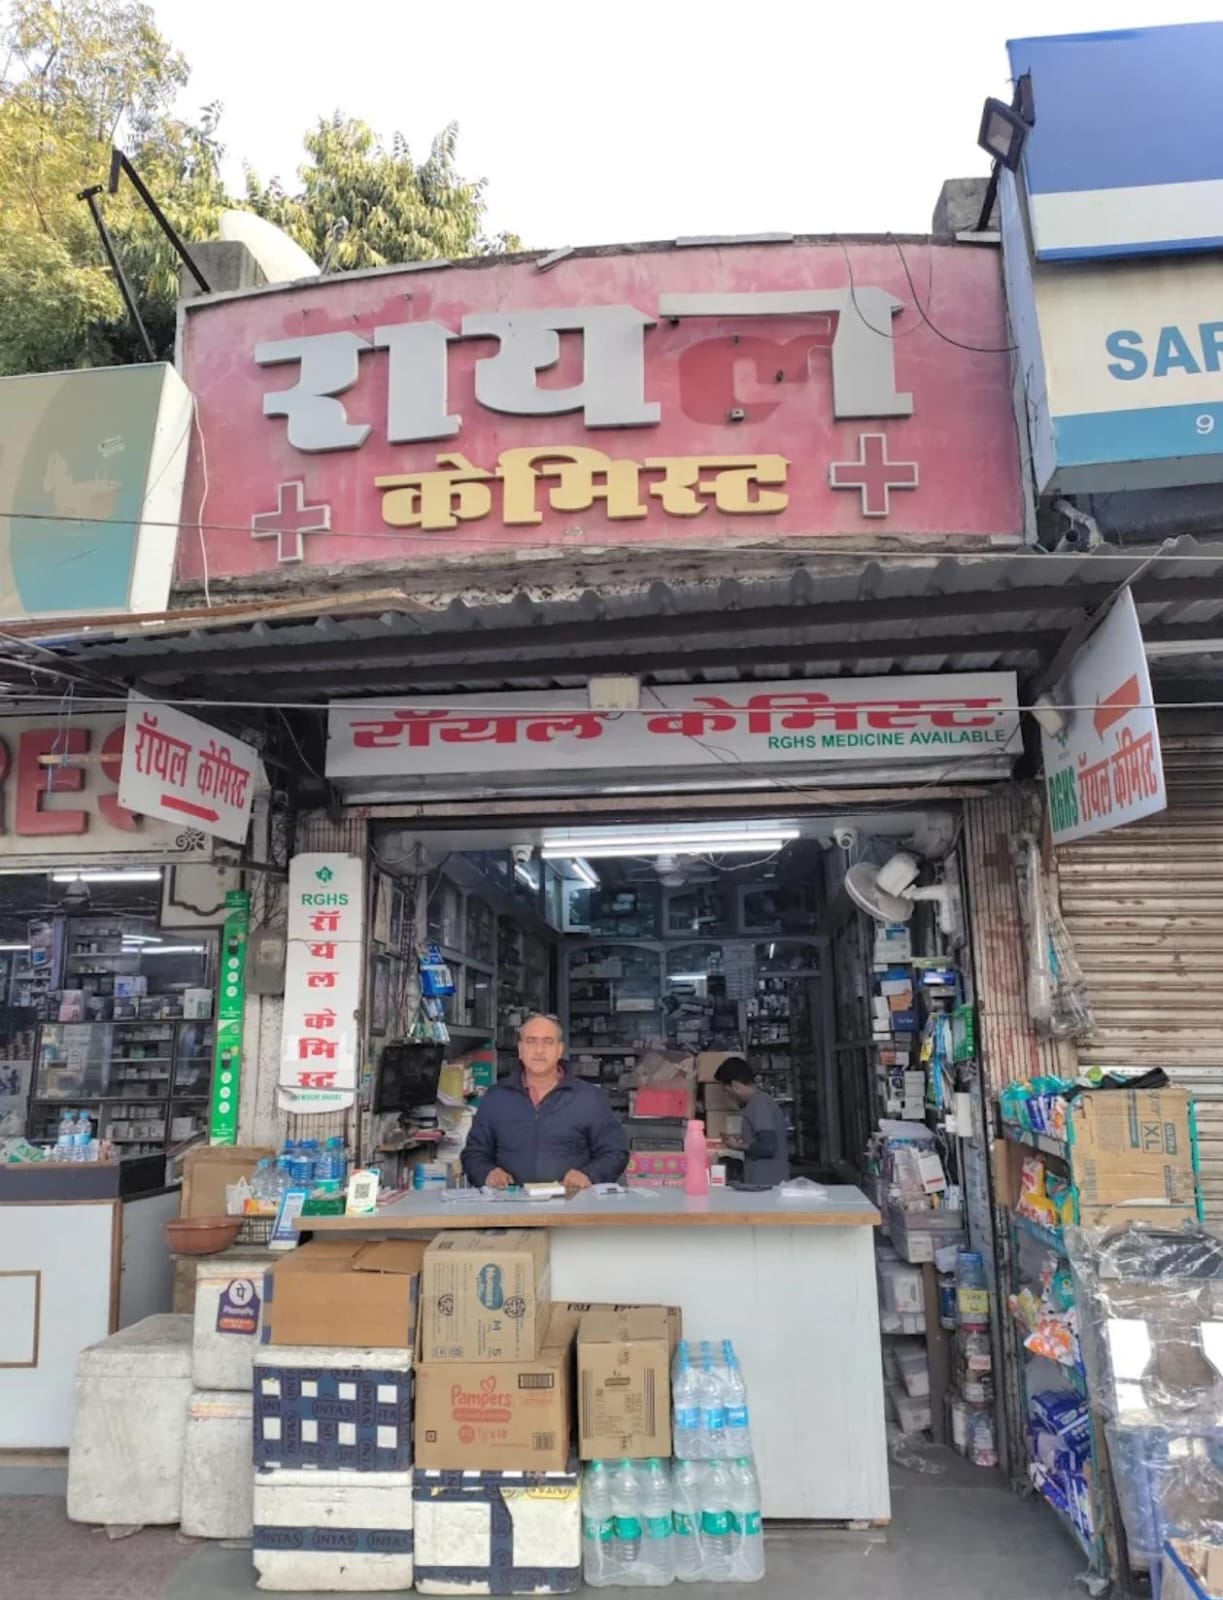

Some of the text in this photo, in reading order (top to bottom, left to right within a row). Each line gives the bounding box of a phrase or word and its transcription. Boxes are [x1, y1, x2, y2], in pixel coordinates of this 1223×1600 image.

[374, 446, 792, 531] केमिस्ट
[349, 692, 1003, 749] रॉयल केमिस्ट
[768, 729, 1006, 749] RGHS MEDICINE AVAILABLE
[135, 711, 250, 809] रॉयल केमिस्ट
[1077, 726, 1158, 822] रॉयल केमिस्ट
[1048, 765, 1079, 832] RGHS
[301, 893, 349, 906] RGHS
[1144, 1124, 1161, 1151] XL
[450, 1384, 513, 1408] Pampers
[315, 1403, 353, 1416] INTAS
[262, 1533, 301, 1545] INTAS
[316, 1534, 355, 1546] INTAS
